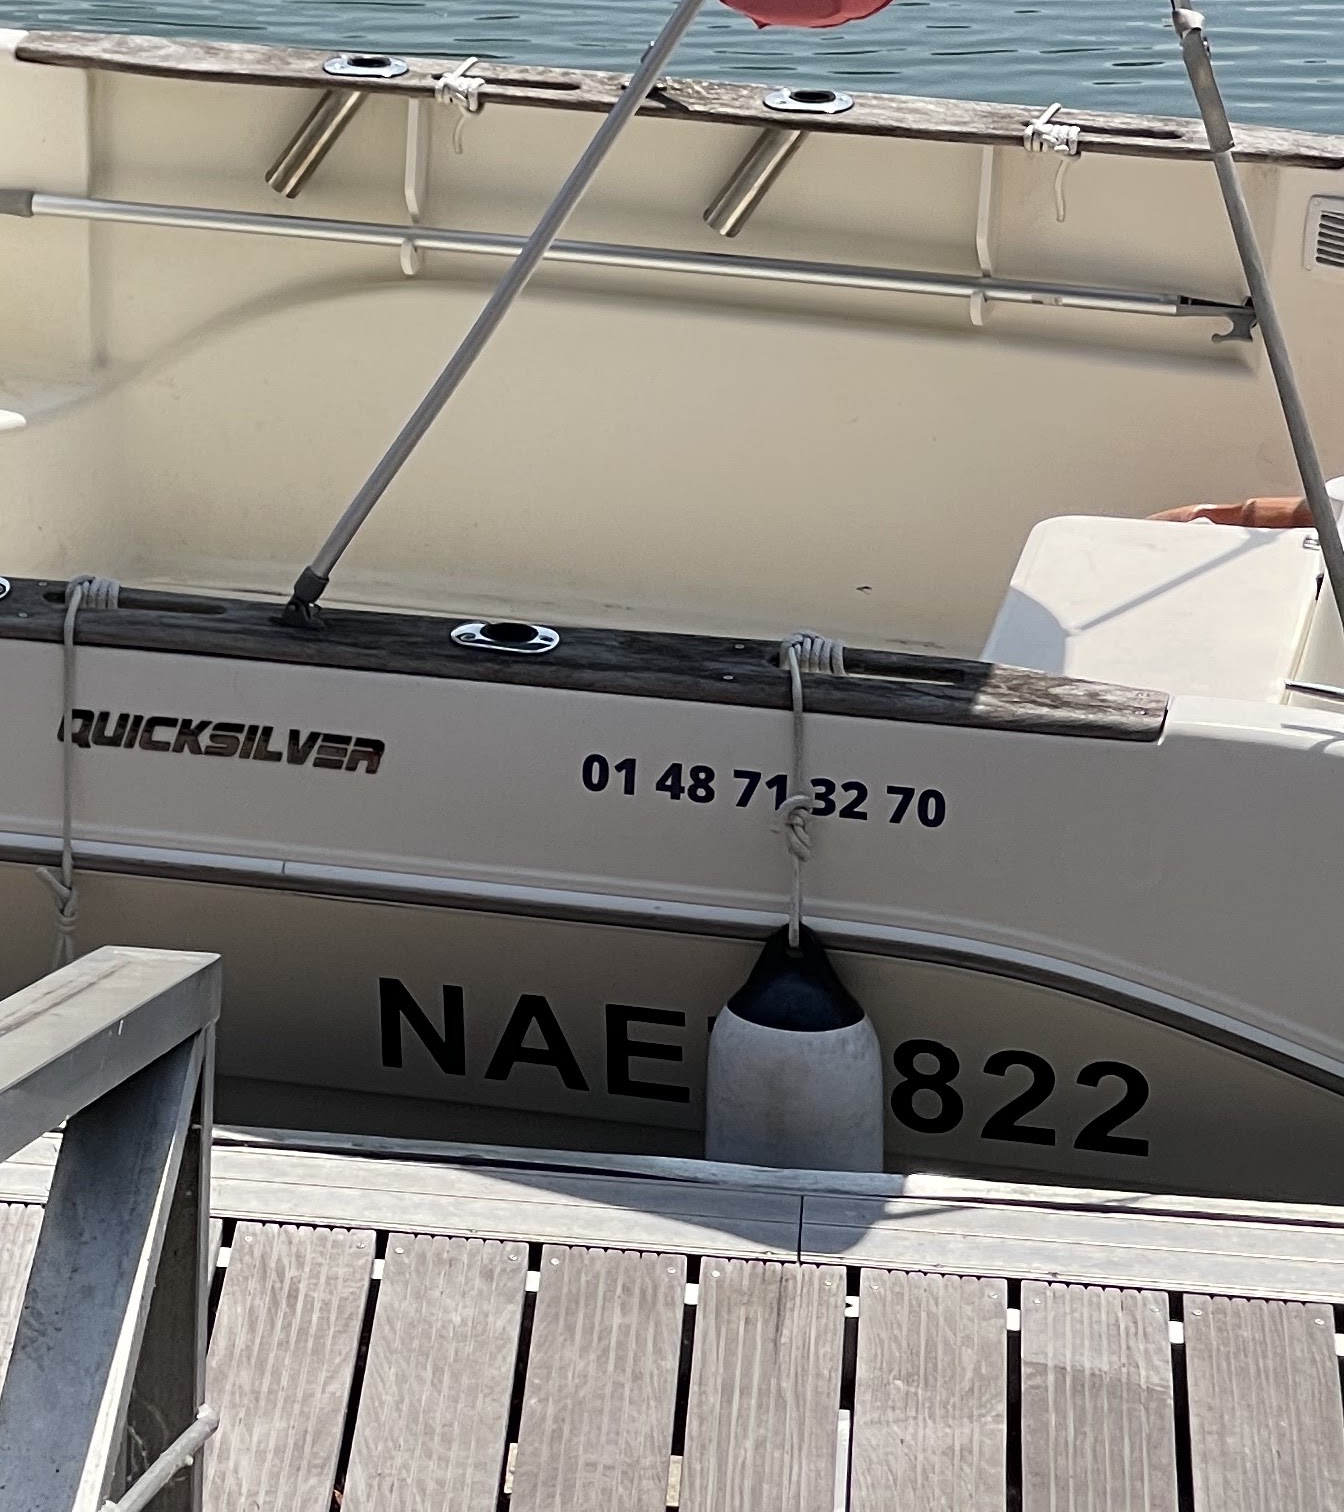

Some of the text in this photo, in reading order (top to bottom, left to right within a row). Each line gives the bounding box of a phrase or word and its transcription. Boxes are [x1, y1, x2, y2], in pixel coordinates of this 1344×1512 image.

[57, 708, 386, 775] QUICKSILVER
[581, 753, 947, 829] 01 48 71 32 70
